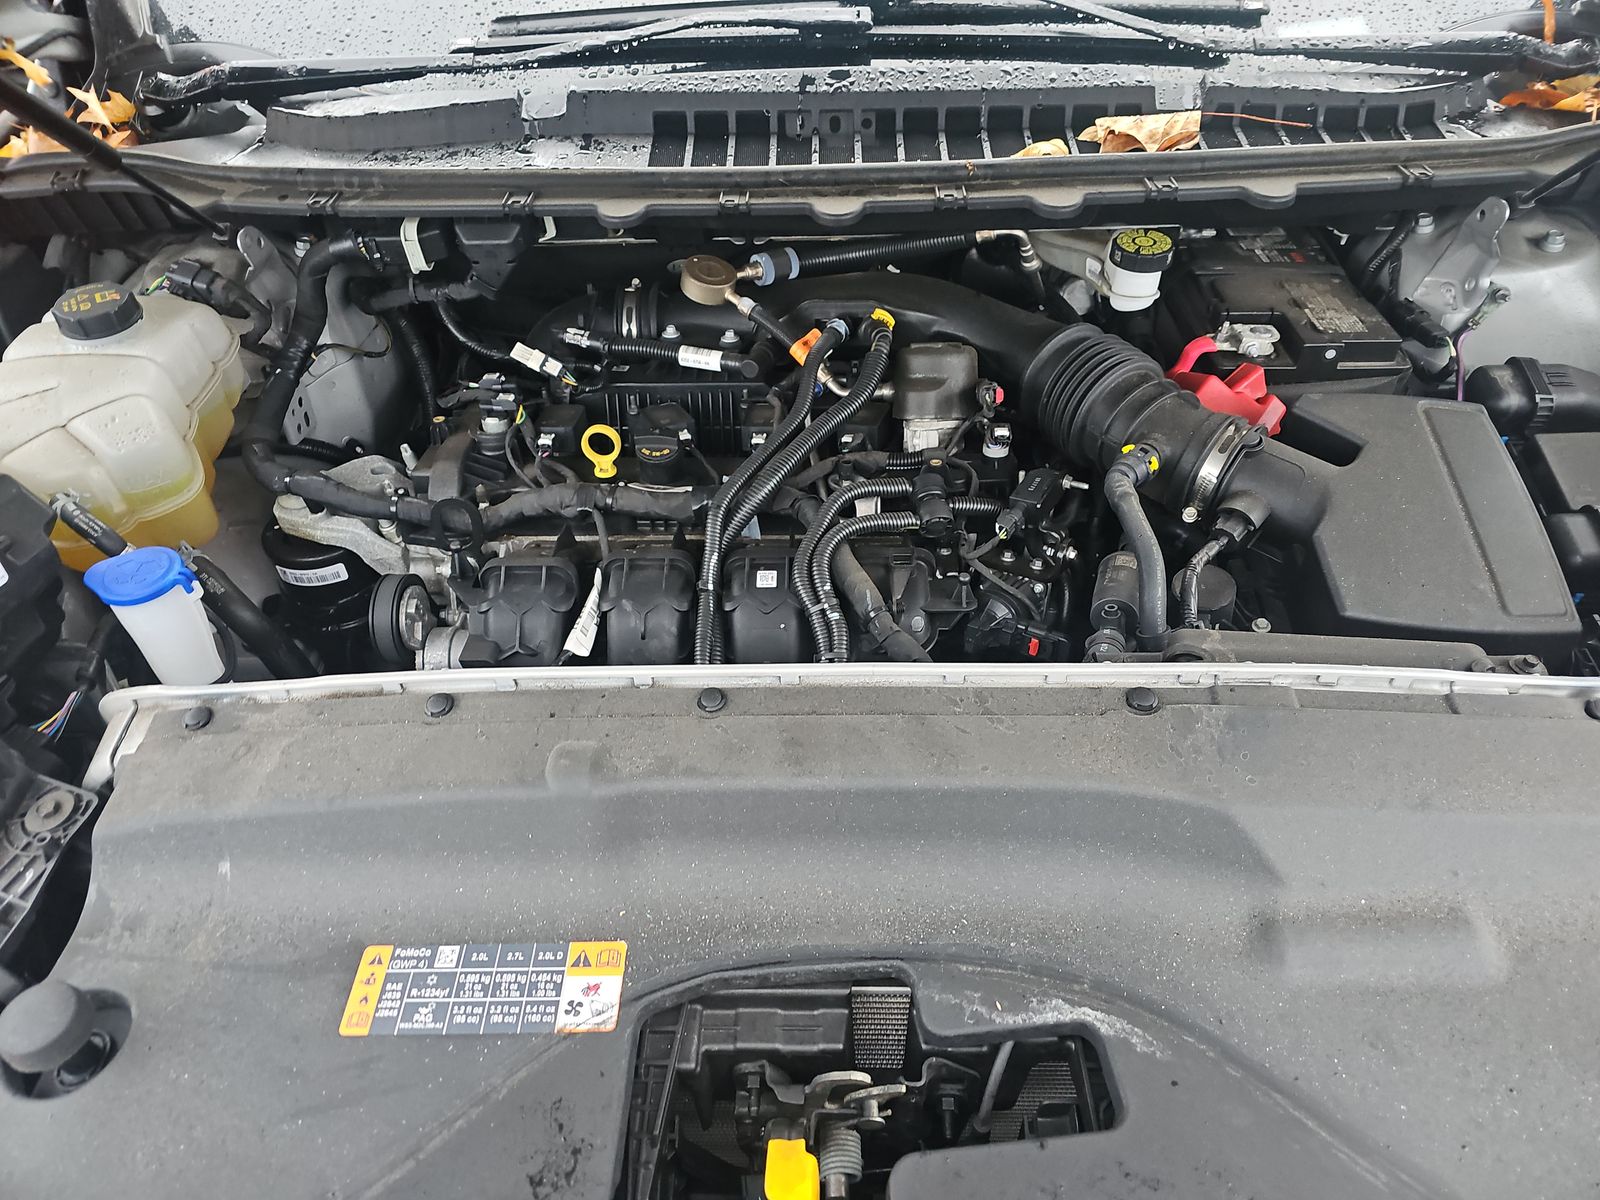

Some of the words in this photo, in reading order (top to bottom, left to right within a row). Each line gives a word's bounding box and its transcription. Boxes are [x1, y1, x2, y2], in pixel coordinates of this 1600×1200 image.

[394, 947, 432, 957] FoMoCo
[471, 952, 489, 962] 2.0L
[507, 952, 524, 961] 2.7L
[538, 951, 555, 960] 2.0L
[557, 951, 564, 960] D
[389, 959, 416, 969] (GWP
[418, 960, 429, 969] 4)
[480, 973, 491, 984] kg
[516, 973, 527, 984] kg
[531, 973, 552, 982] 0.454
[552, 973, 562, 984] kg
[410, 987, 449, 998] R-1234yf
[412, 1013, 433, 1023] PAG
